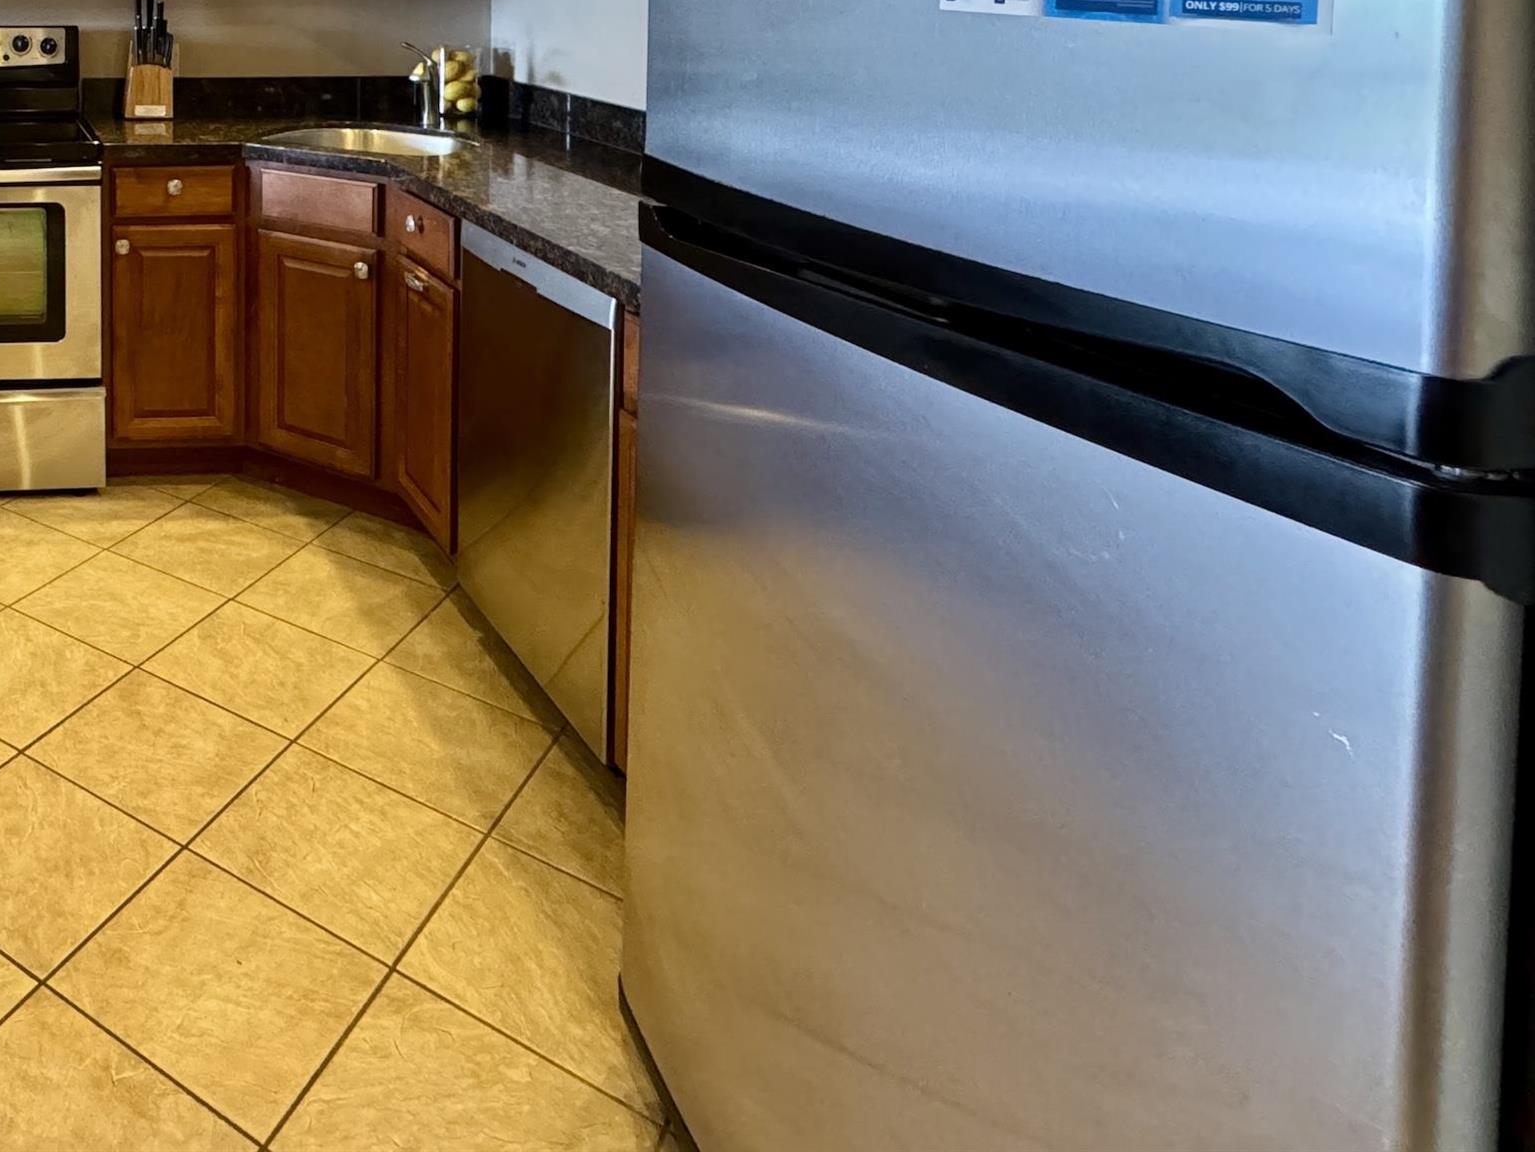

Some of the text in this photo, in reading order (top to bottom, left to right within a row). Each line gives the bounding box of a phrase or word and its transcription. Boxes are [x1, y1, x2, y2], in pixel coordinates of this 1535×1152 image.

[1185, 0, 1217, 11] ONLY
[1243, 2, 1264, 12] FOR
[1273, 4, 1301, 14] DAYS
